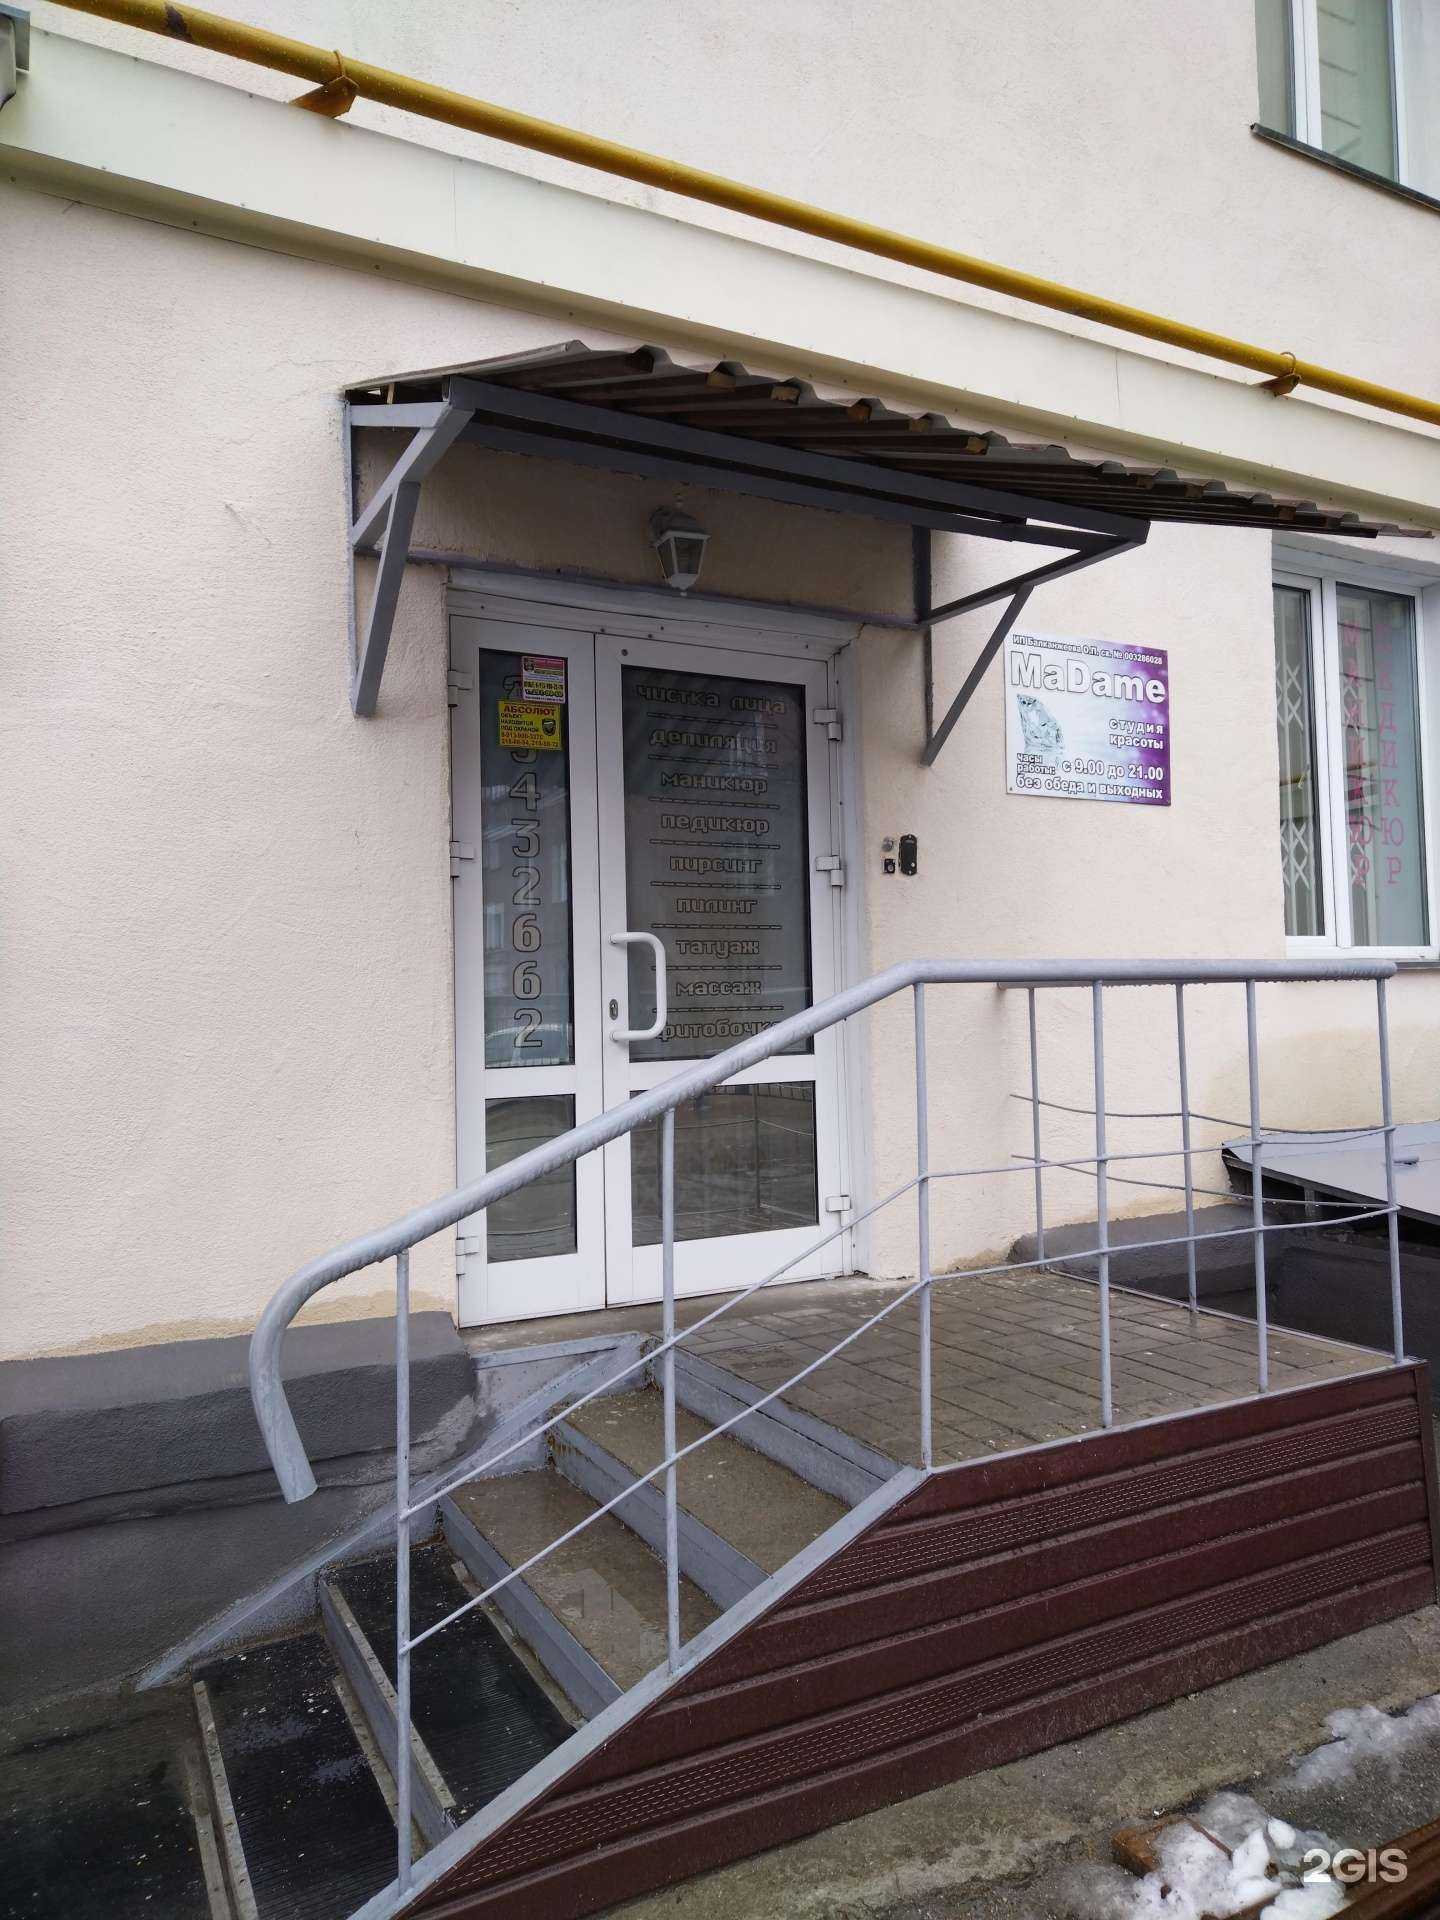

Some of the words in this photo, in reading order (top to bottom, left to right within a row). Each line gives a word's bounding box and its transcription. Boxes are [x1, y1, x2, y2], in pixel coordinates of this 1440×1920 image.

[1013, 634, 1026, 645] ИП
[1010, 650, 1166, 704] MaDame
[504, 704, 556, 715] АБСОЛЮТ
[636, 685, 720, 707] чистка
[730, 696, 787, 715] лица
[1109, 718, 1164, 735] студия
[650, 729, 777, 753] депиляция
[1109, 733, 1164, 750] красоты
[1016, 763, 1056, 775] работы:
[1062, 760, 1071, 773] с
[1074, 759, 1104, 775] 9.00
[1107, 764, 1125, 779] до
[1128, 764, 1164, 781] 21.00
[660, 771, 768, 795] маникюр
[1016, 774, 1041, 789] без
[1045, 777, 1084, 794] обеда
[1088, 783, 1096, 793] и
[1099, 782, 1163, 799] выходных
[661, 814, 769, 835] педикюр
[669, 856, 763, 875] пирсинг
[676, 898, 758, 914] пилинг
[675, 939, 760, 959] татуаж
[675, 980, 762, 997] массаж
